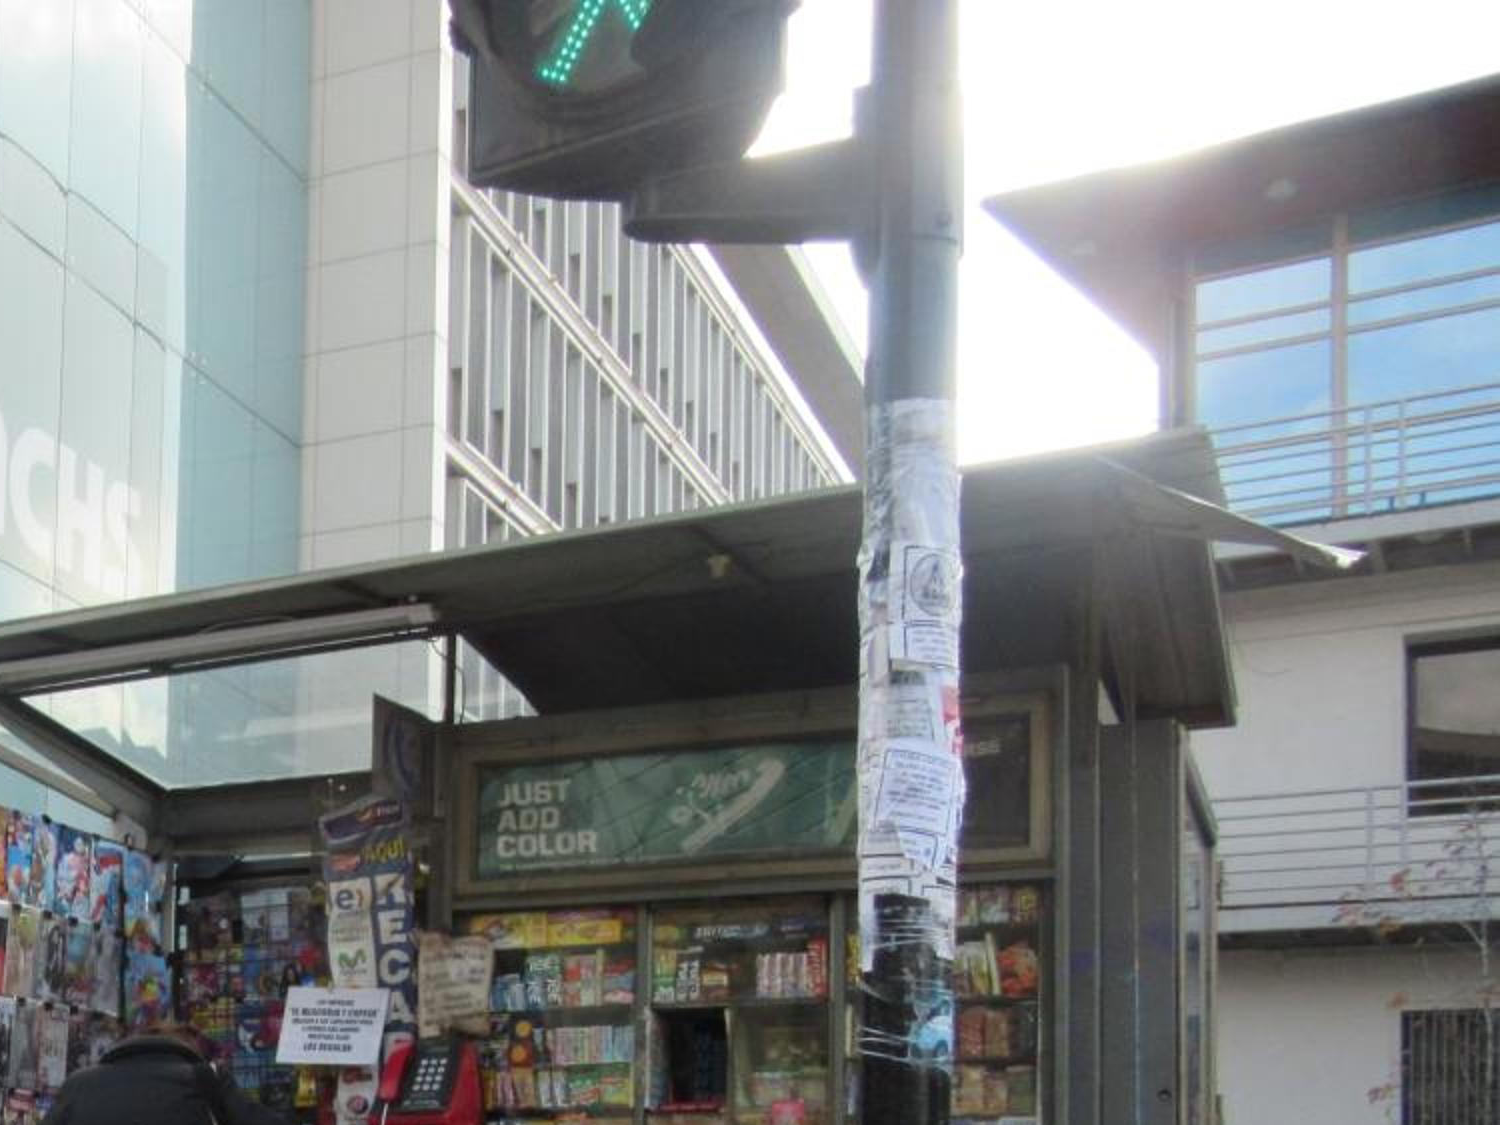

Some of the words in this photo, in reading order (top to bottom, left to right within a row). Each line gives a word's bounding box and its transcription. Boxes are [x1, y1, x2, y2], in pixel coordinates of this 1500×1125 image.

[497, 779, 571, 807] JUST
[497, 807, 560, 833] ADD
[496, 829, 598, 858] COLOR
